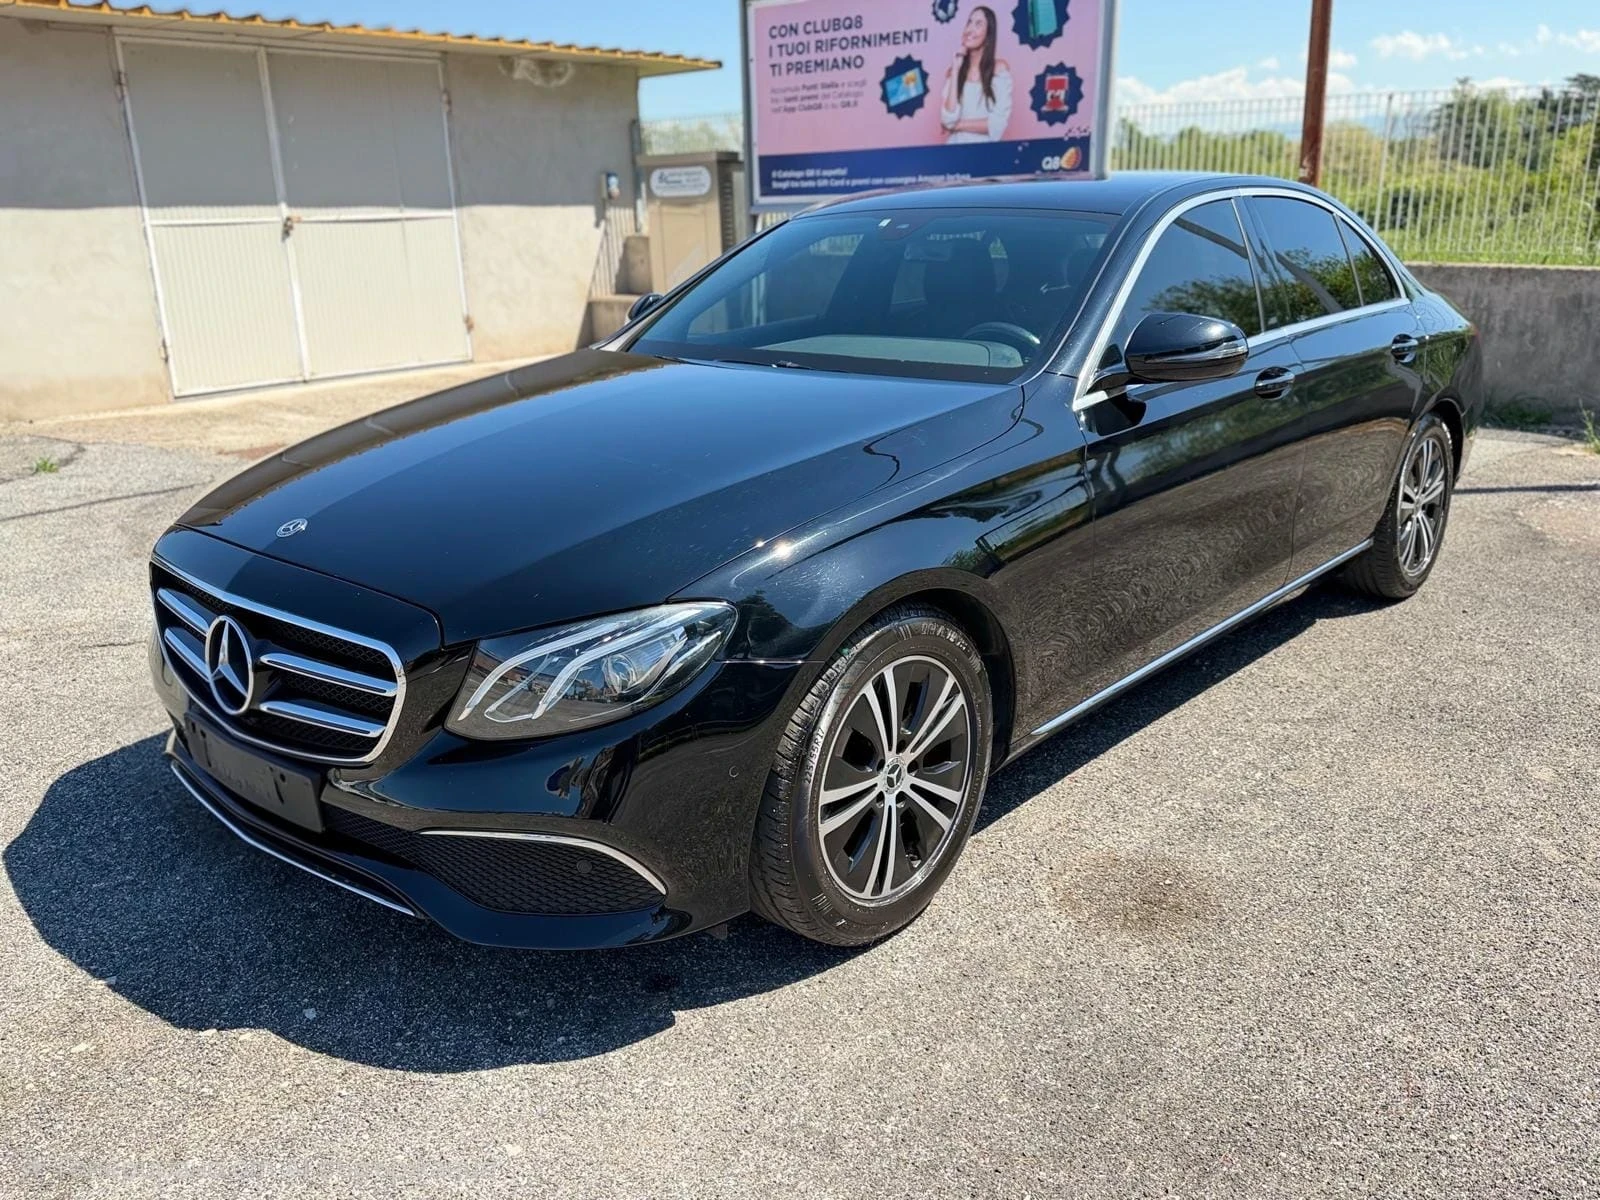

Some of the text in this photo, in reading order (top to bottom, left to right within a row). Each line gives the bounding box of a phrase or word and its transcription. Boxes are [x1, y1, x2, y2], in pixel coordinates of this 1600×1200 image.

[769, 15, 863, 39] CON CLUBQ8
[769, 28, 928, 59] I TUOI RIFORNIMENTI
[769, 55, 864, 77] TI PREMIANO
[1041, 155, 1061, 170] Q8
